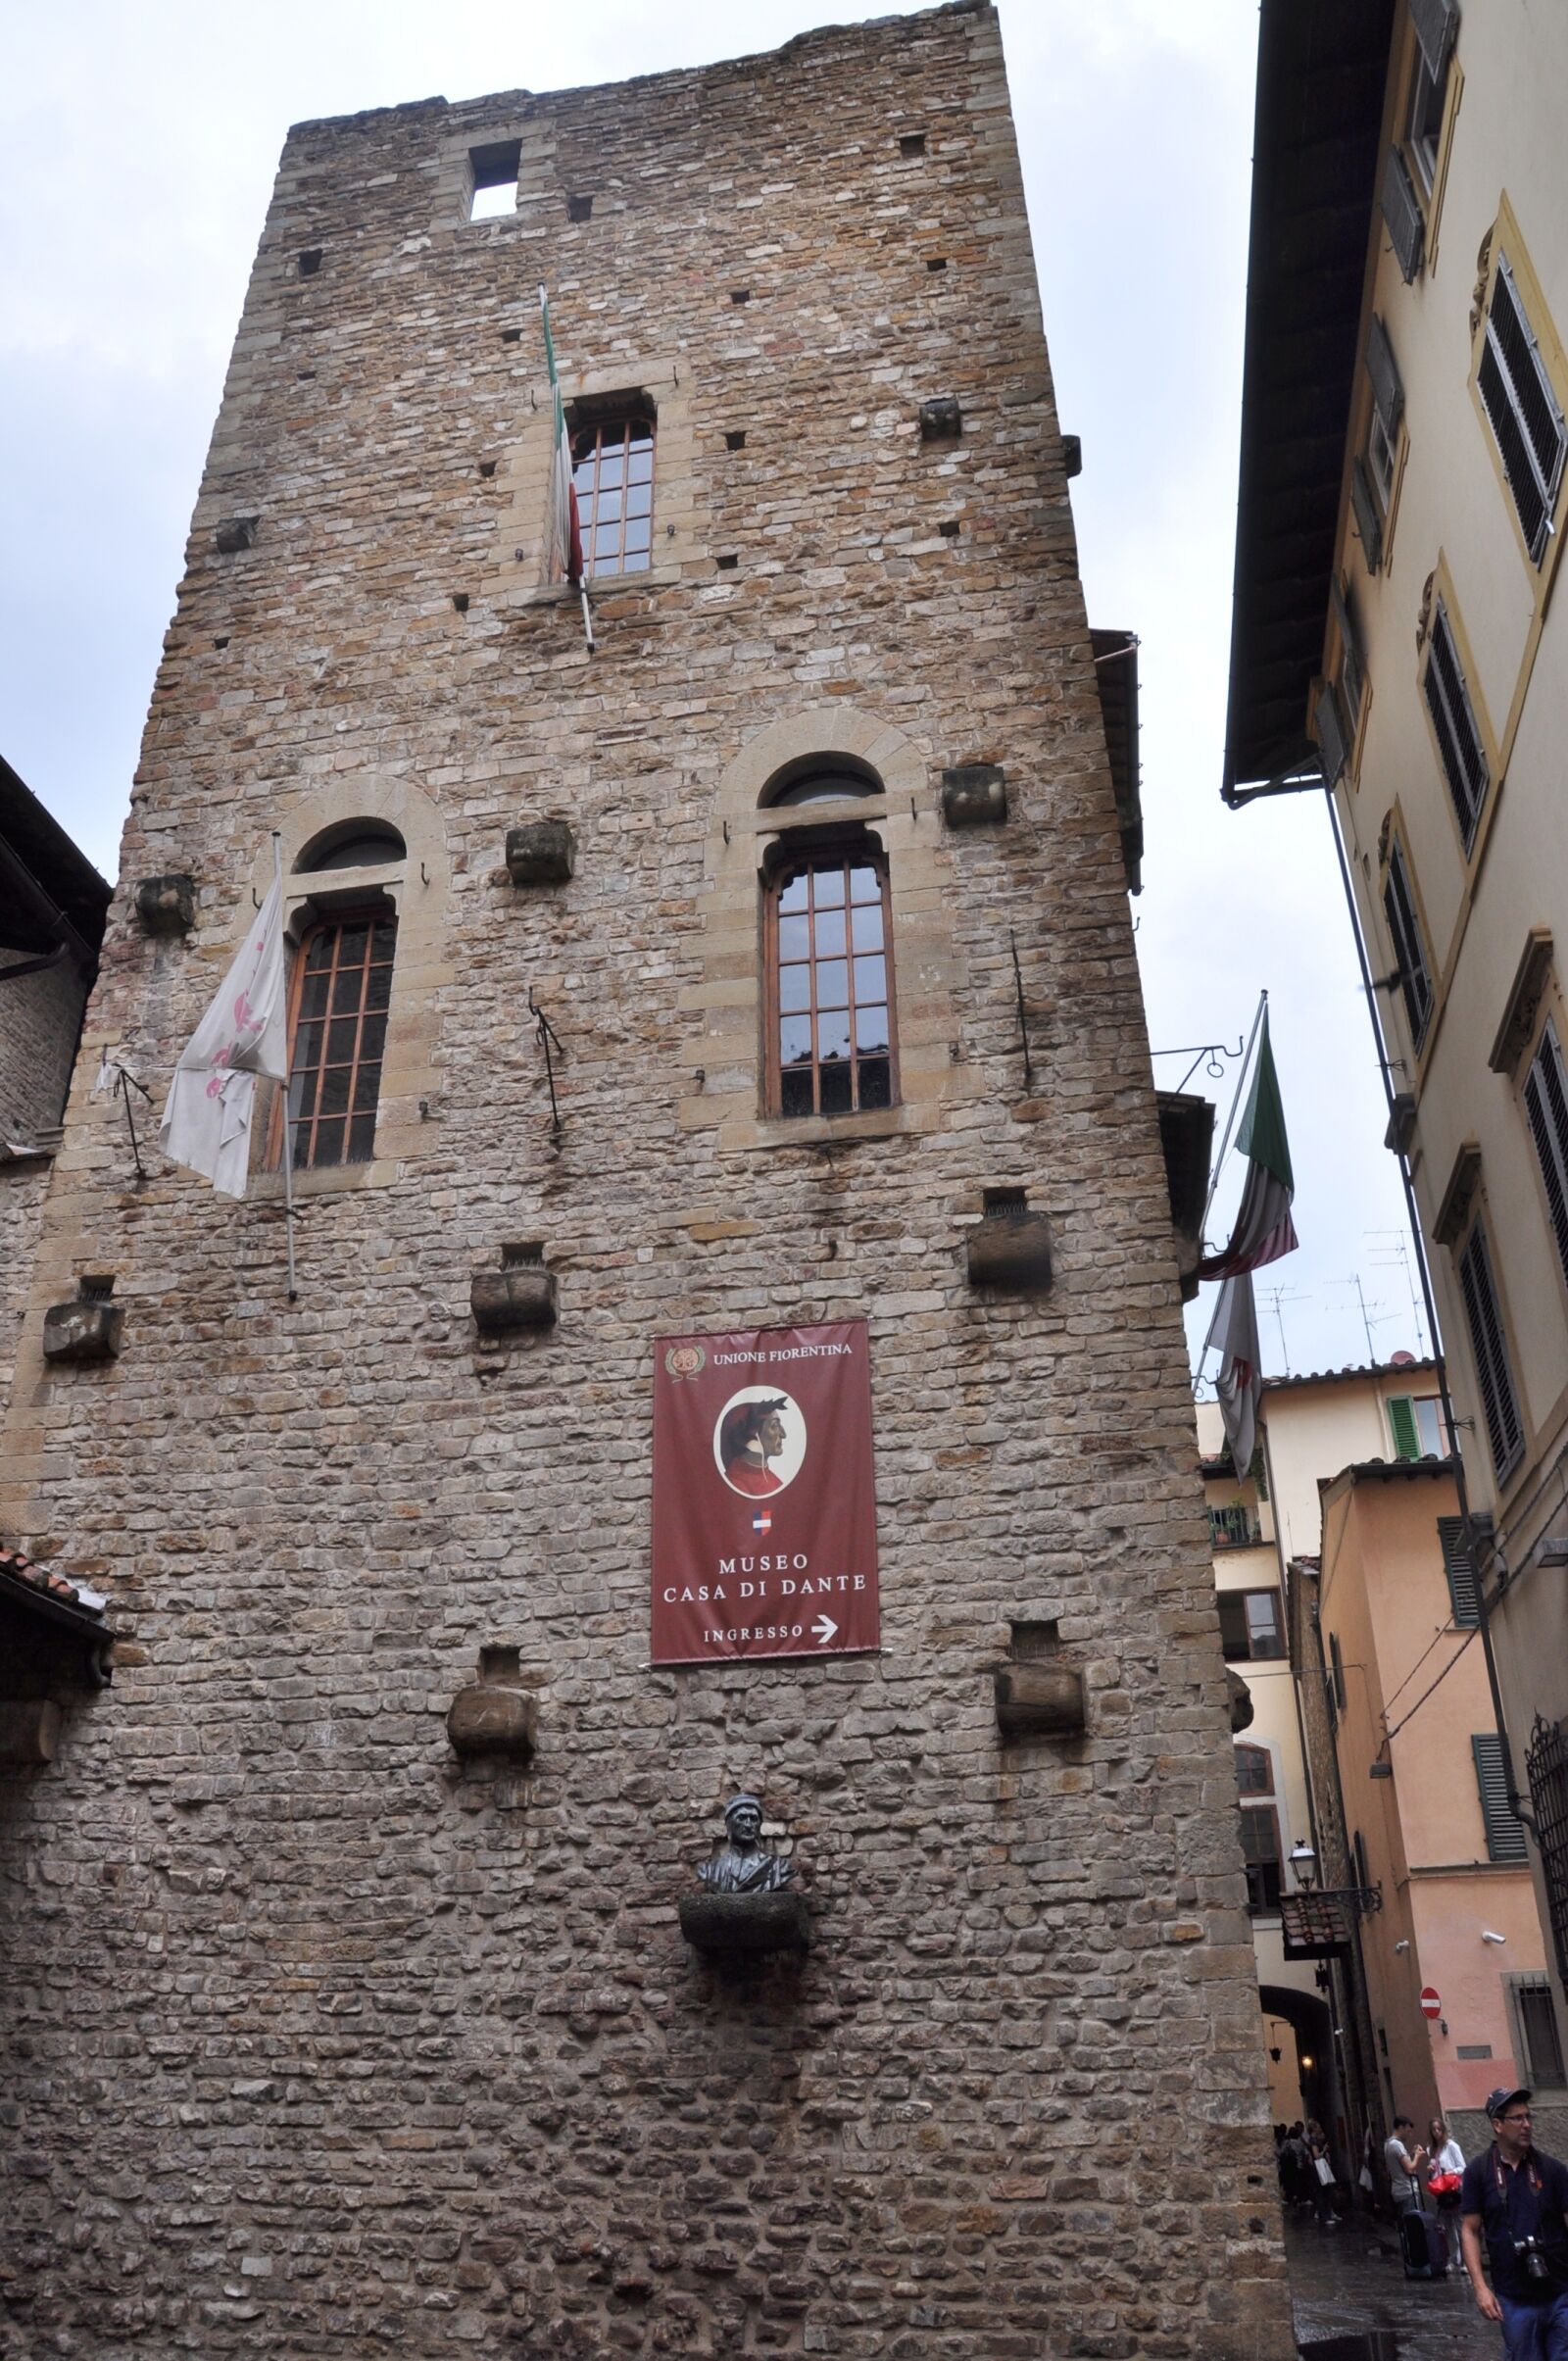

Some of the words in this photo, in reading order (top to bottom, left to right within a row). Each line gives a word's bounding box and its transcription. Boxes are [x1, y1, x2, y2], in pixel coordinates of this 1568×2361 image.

[713, 1352, 766, 1365] UNIONE
[769, 1344, 853, 1361] FIORENTINA
[718, 1553, 808, 1574] MUSEO
[663, 1584, 726, 1603] CASA
[740, 1581, 766, 1598] DI
[781, 1574, 866, 1596] DANTE
[704, 1624, 803, 1643] INGRESSO
